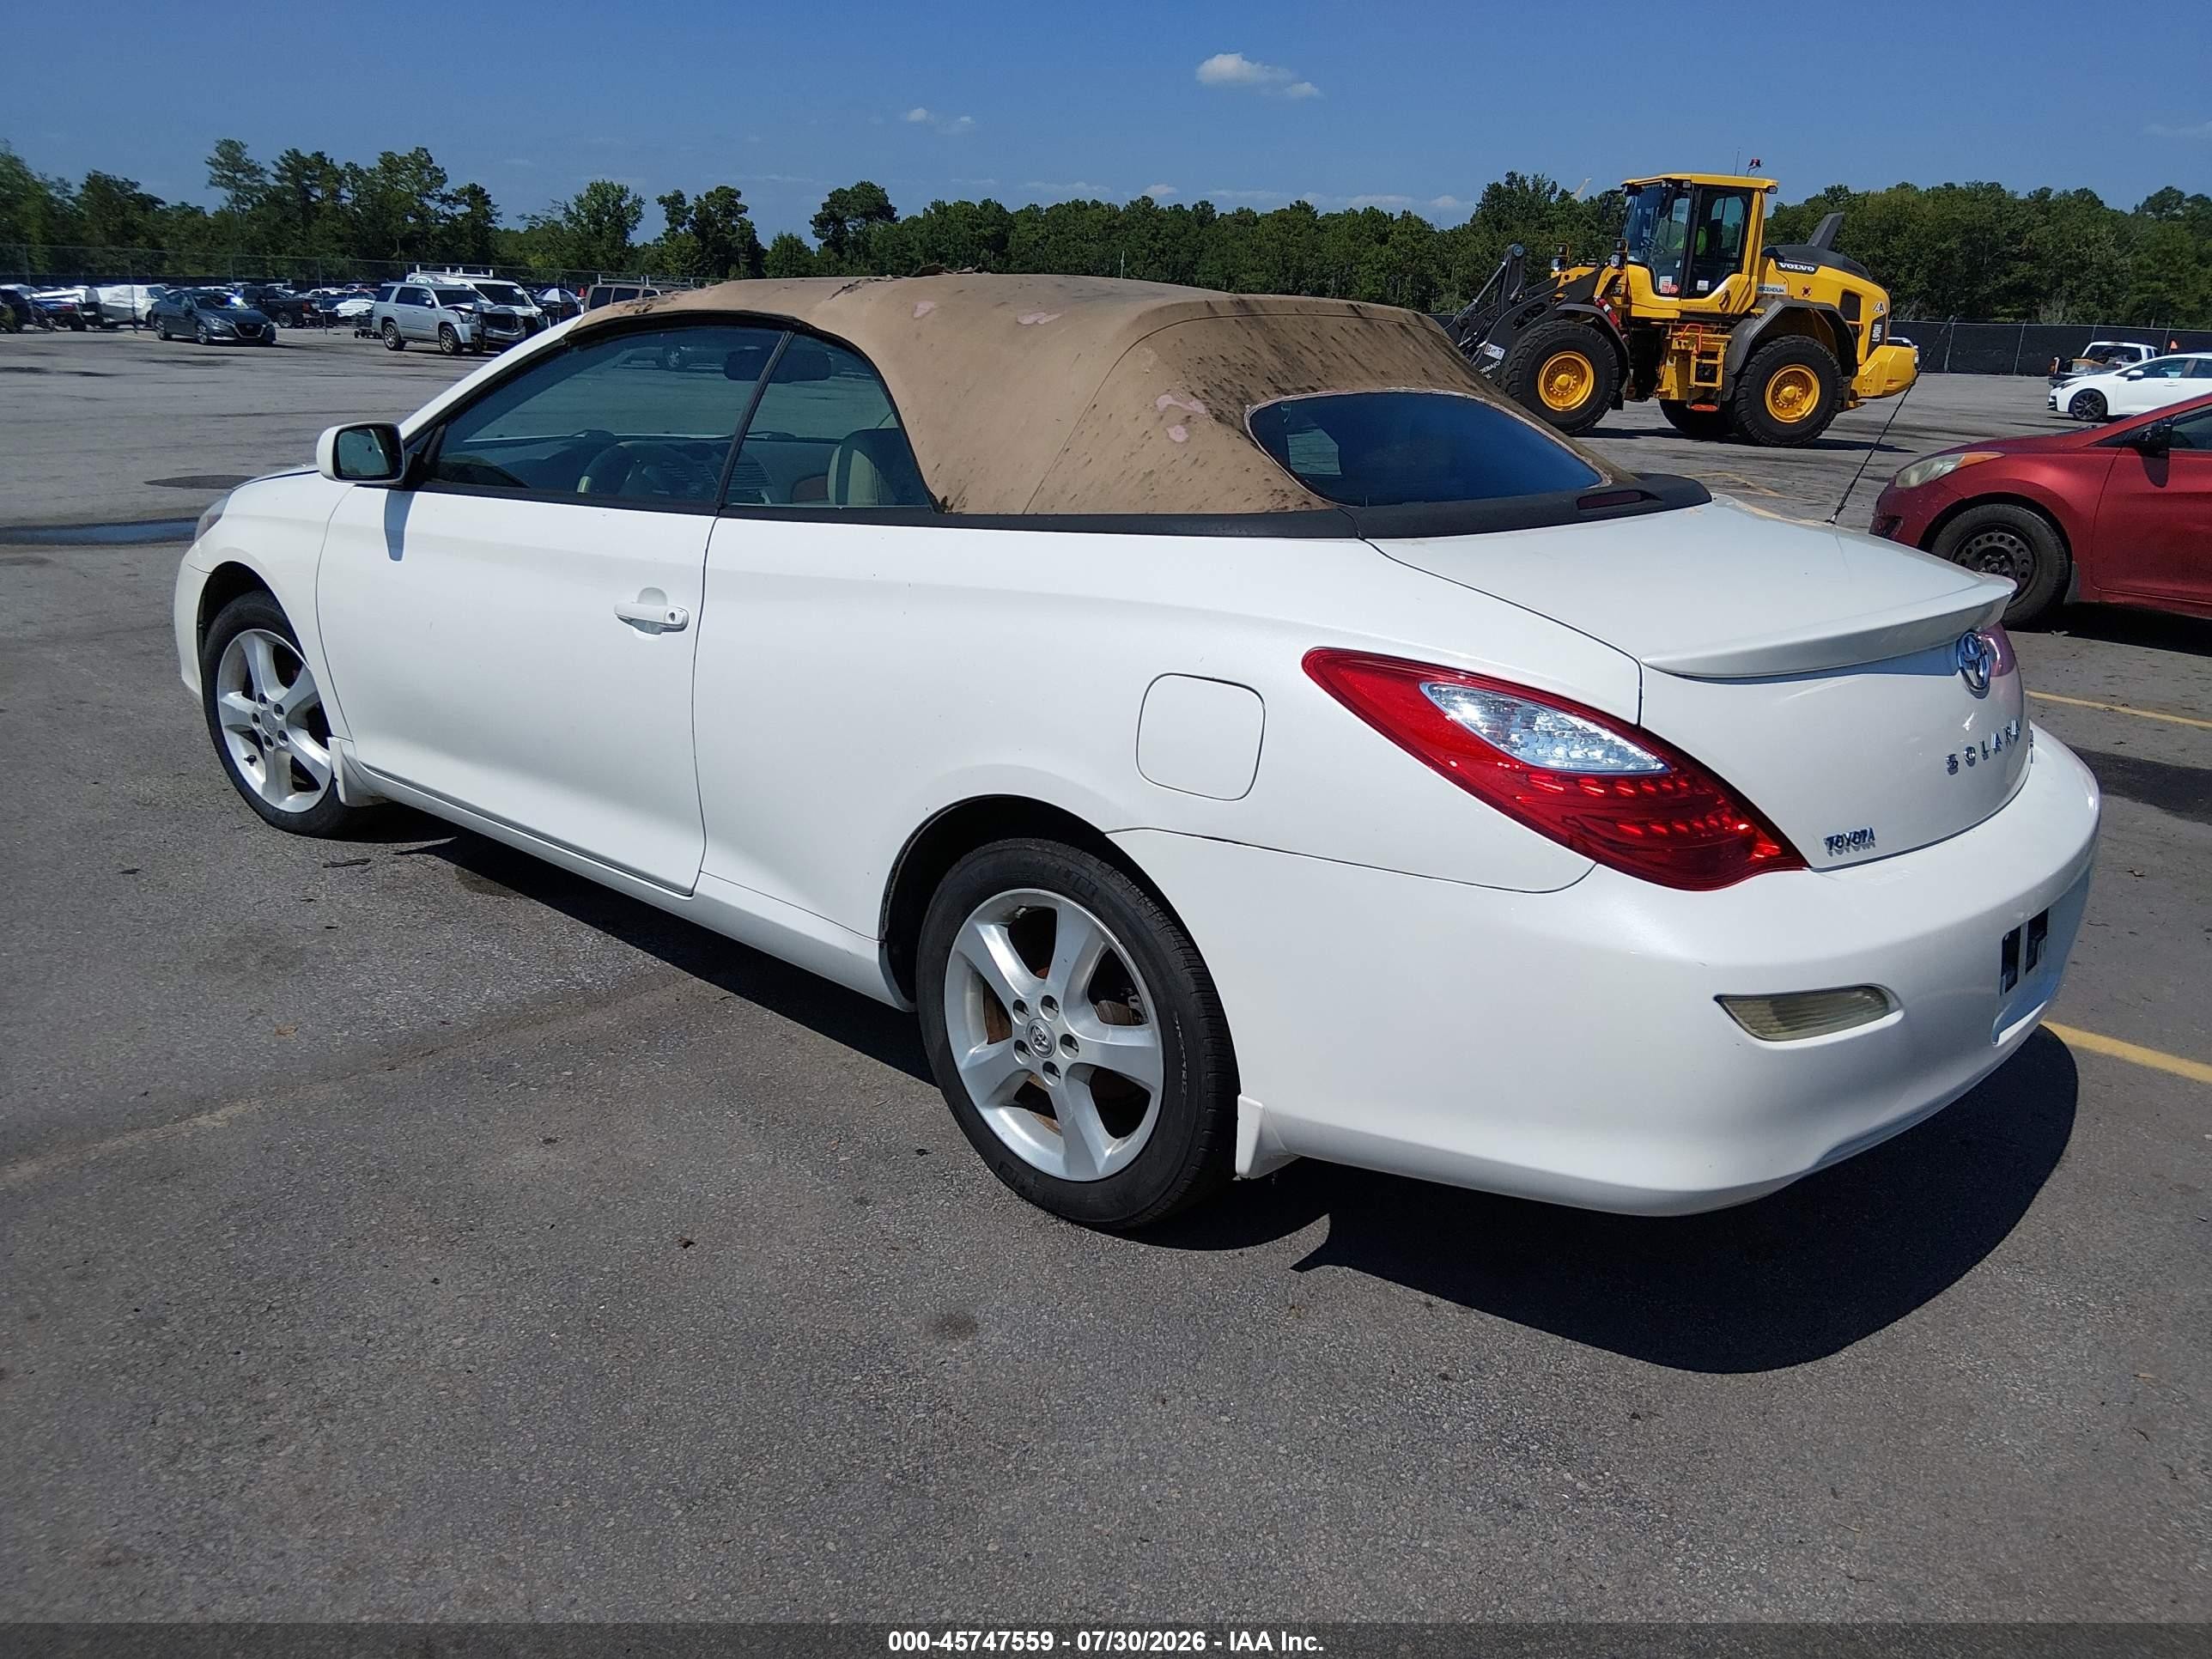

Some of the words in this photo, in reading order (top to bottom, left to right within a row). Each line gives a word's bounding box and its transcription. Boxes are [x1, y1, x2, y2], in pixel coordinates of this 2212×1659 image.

[1778, 262, 1815, 272] VOLVO
[1944, 720, 2021, 772] SOLARA
[1824, 827, 1875, 852] TOYOTA
